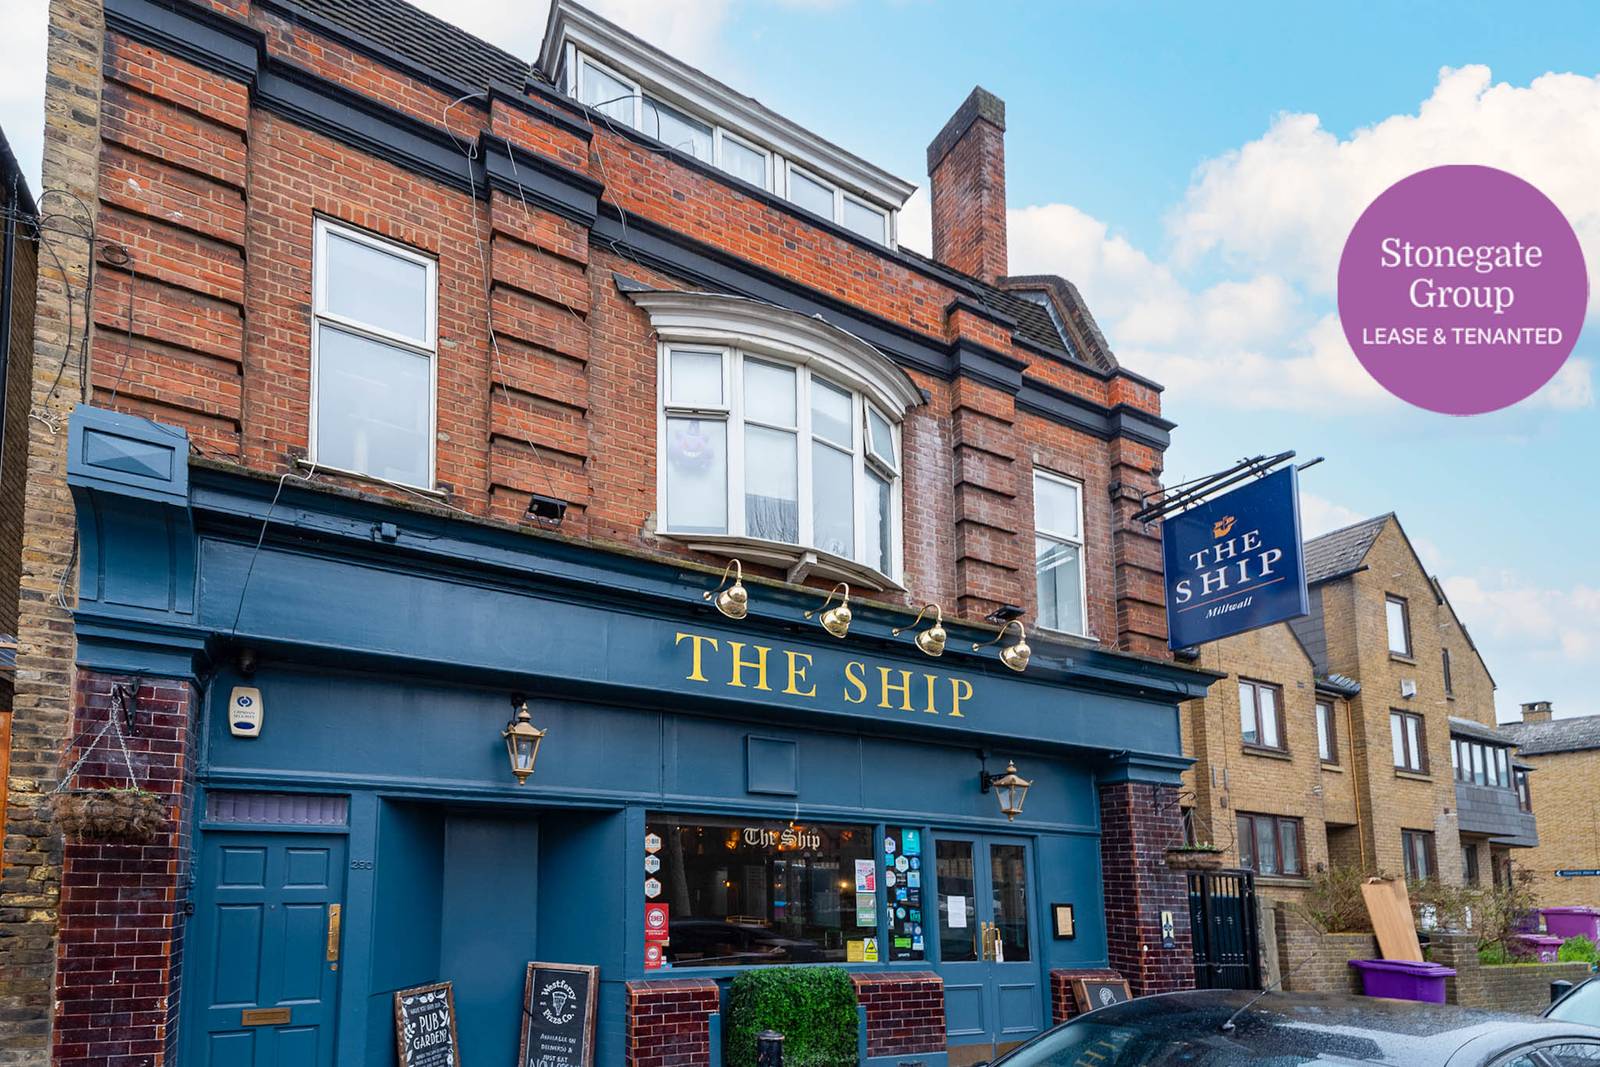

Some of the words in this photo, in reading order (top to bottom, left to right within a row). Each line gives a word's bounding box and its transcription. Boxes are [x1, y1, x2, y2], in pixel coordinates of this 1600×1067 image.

[1189, 529, 1262, 570] THE
[1176, 548, 1282, 604] SHIP
[1206, 596, 1253, 619] Millwall
[675, 632, 817, 698] THE
[844, 661, 974, 718] SHIP
[744, 827, 779, 848] The
[781, 829, 820, 851] Ship
[541, 980, 576, 1000] Westferry
[419, 1012, 439, 1034] PUB
[543, 1009, 563, 1025] Pizza
[562, 1013, 575, 1023] Co.
